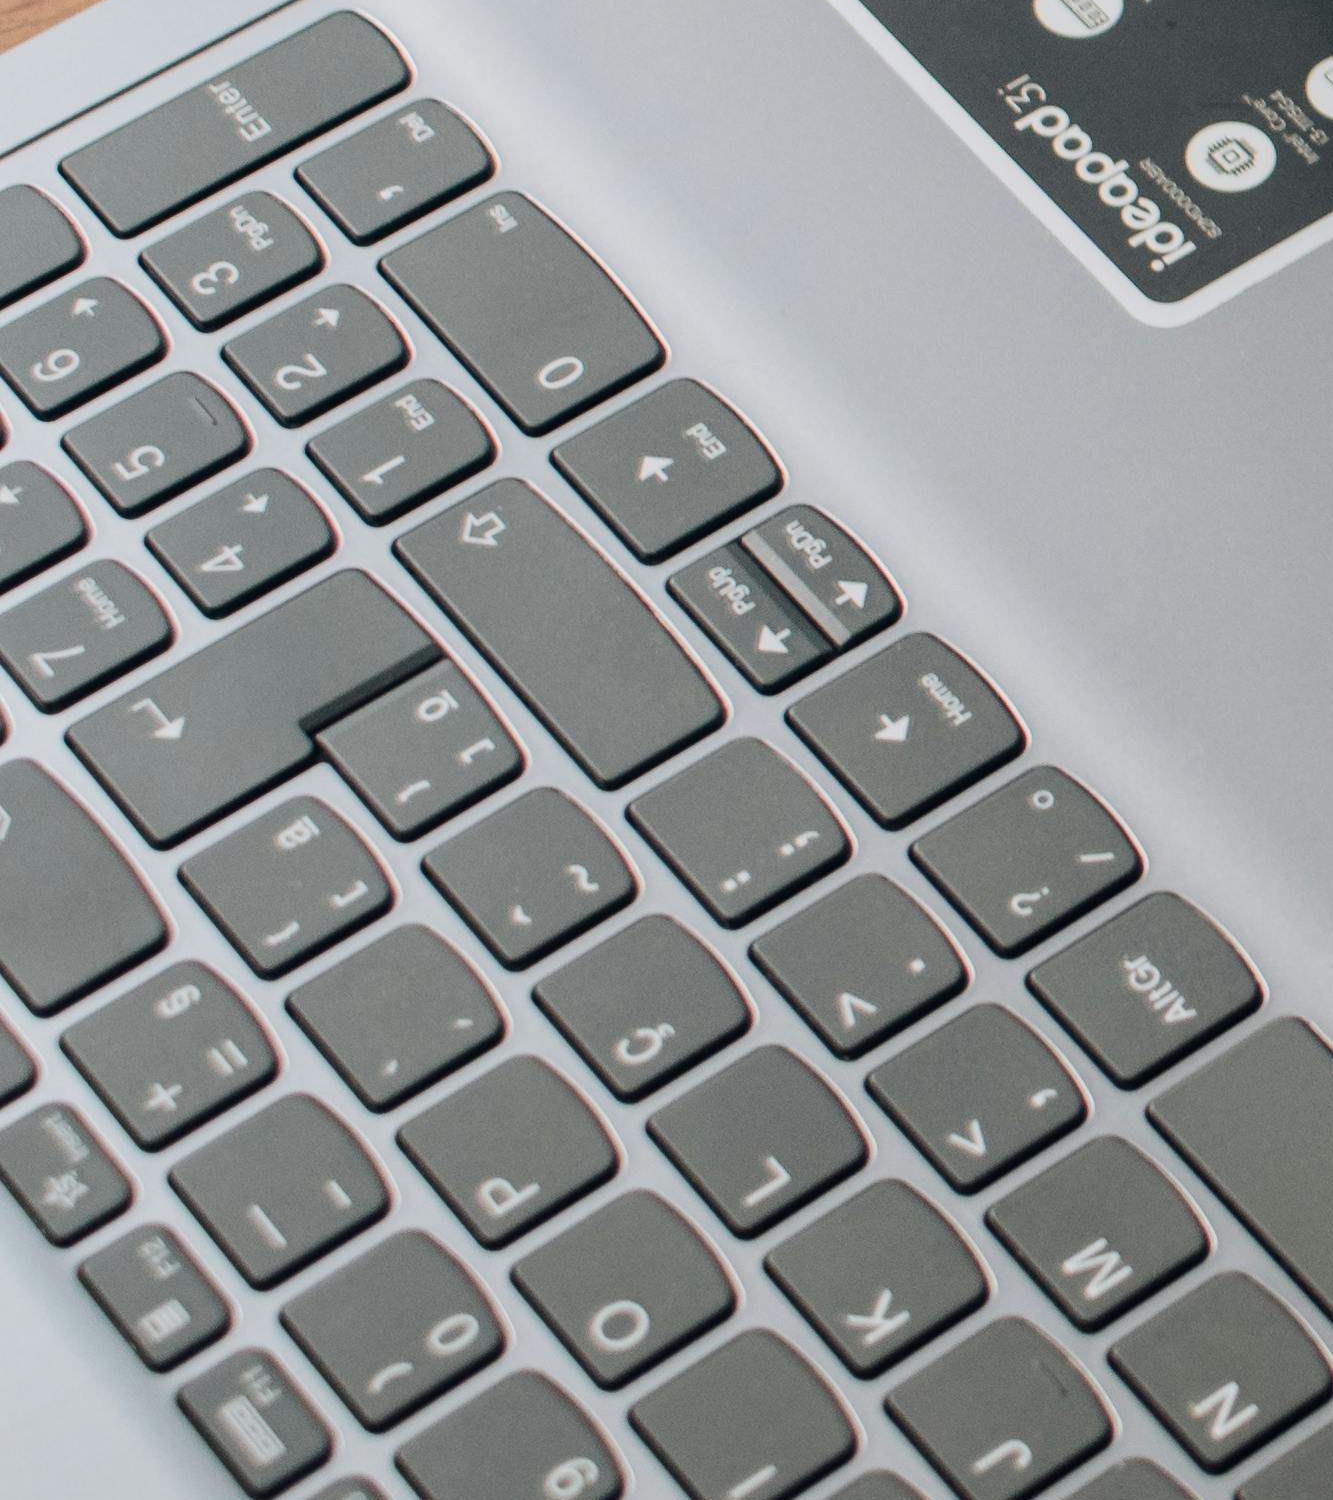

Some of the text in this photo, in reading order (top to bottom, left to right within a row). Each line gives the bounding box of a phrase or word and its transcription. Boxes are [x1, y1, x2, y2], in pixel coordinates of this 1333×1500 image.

[210, 84, 269, 140] Enter
[401, 114, 432, 141] Del
[232, 208, 271, 249] PgDn
[490, 206, 515, 230] Ins
[193, 263, 237, 293] 3
[34, 351, 78, 380] 6
[277, 356, 325, 388] 2
[539, 358, 582, 388] 0
[396, 396, 432, 429] End
[686, 424, 725, 458] End
[115, 447, 163, 478] 5
[363, 457, 403, 483] 1
[201, 547, 241, 570] 4
[785, 522, 830, 567] PgDn
[77, 580, 123, 627] Home
[709, 568, 753, 614] PgUp
[32, 648, 82, 675] 7
[921, 675, 970, 724] Home
[1010, 886, 1049, 917] ?
[1124, 957, 1195, 1022] AltGr
[616, 1025, 673, 1063] Ç
[148, 1085, 179, 1108] +
[479, 1179, 537, 1215] P
[744, 1158, 789, 1205] L
[142, 1240, 177, 1276] F12
[1060, 1237, 1133, 1299] M
[428, 1315, 477, 1354] 0
[590, 1302, 648, 1351] O
[847, 1291, 908, 1344] K
[1191, 1383, 1257, 1439] N
[974, 1441, 1030, 1472] J
[545, 1459, 597, 1500] 9
